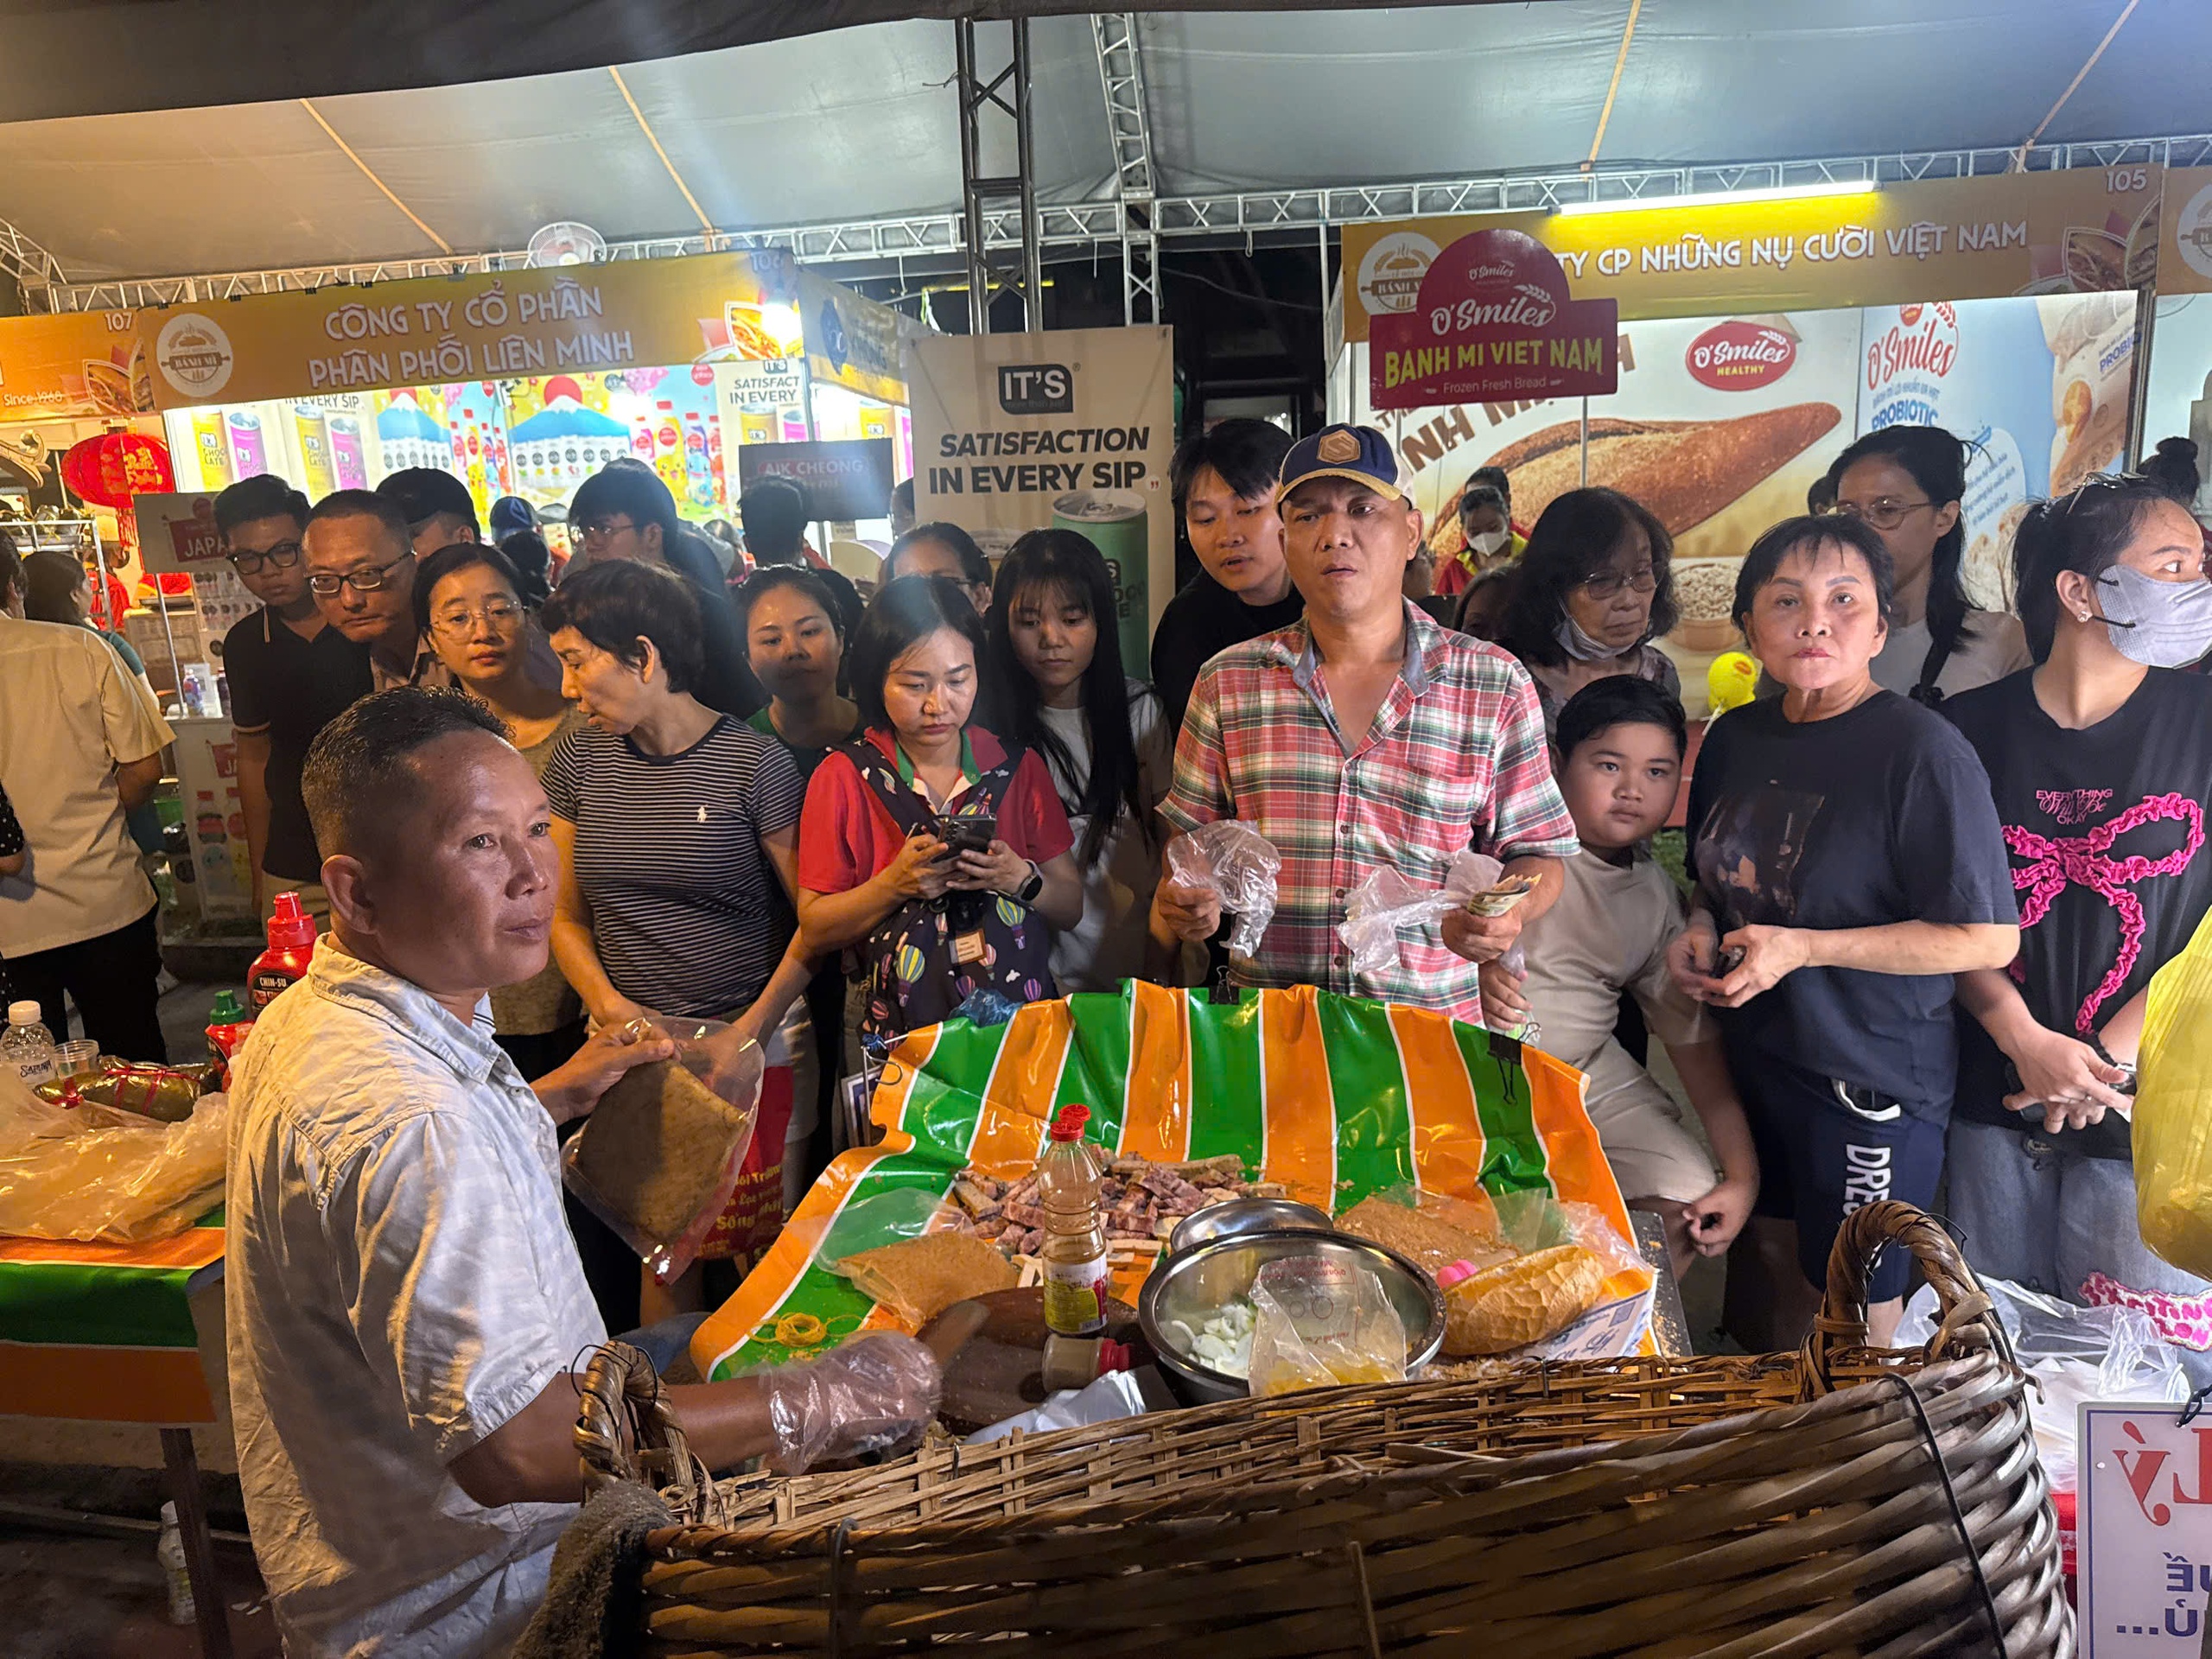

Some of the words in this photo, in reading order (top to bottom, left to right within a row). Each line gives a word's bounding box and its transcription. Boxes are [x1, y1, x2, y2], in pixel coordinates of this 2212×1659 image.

[2107, 168, 2147, 193] 105
[1556, 251, 1588, 279] TY
[1597, 248, 1632, 276] CP
[1641, 233, 1742, 274] NHỮNG
[1751, 238, 1794, 270] NỤ
[1803, 225, 1875, 260] CƯỜI
[1884, 220, 1948, 260] VIỆT
[1958, 221, 2027, 250] NAM
[324, 302, 410, 340] CÔNG
[416, 301, 453, 332] TY
[464, 279, 508, 328] CỔ
[518, 276, 603, 324] PHẦN
[1430, 296, 1555, 335] O'Smiles
[105, 312, 133, 332] 107
[308, 349, 392, 389] PHÂN
[400, 334, 474, 379] PHỐI
[482, 334, 546, 372] LIÊN
[555, 330, 635, 367] MINH
[1694, 334, 1789, 368] O'Smiles
[1385, 347, 1450, 388] BANH
[1458, 343, 1484, 367] MI
[1491, 340, 1543, 365] VIET
[1550, 337, 1603, 375] NAM
[1716, 364, 1765, 377] HEALTHY
[734, 376, 800, 390] SATISFACT
[1443, 380, 1478, 394] Frozen
[1482, 378, 1511, 391] Fresh
[1515, 377, 1547, 390] Bread
[3, 392, 33, 406] Since
[342, 395, 359, 408] SIP
[730, 392, 747, 404] IN
[748, 389, 797, 404] EVERY
[1872, 398, 1939, 431] PROBIOTIC
[940, 426, 1150, 458] SATISFACTION
[797, 460, 863, 474] CHEONG
[929, 467, 963, 494] IN
[972, 463, 1084, 493] EVERY
[1093, 461, 1147, 489] SIP
[2036, 788, 2113, 801] EVERYTHING
[2039, 797, 2074, 816] Will
[2056, 812, 2088, 825] OKAY
[1844, 1143, 1891, 1215] DRE
